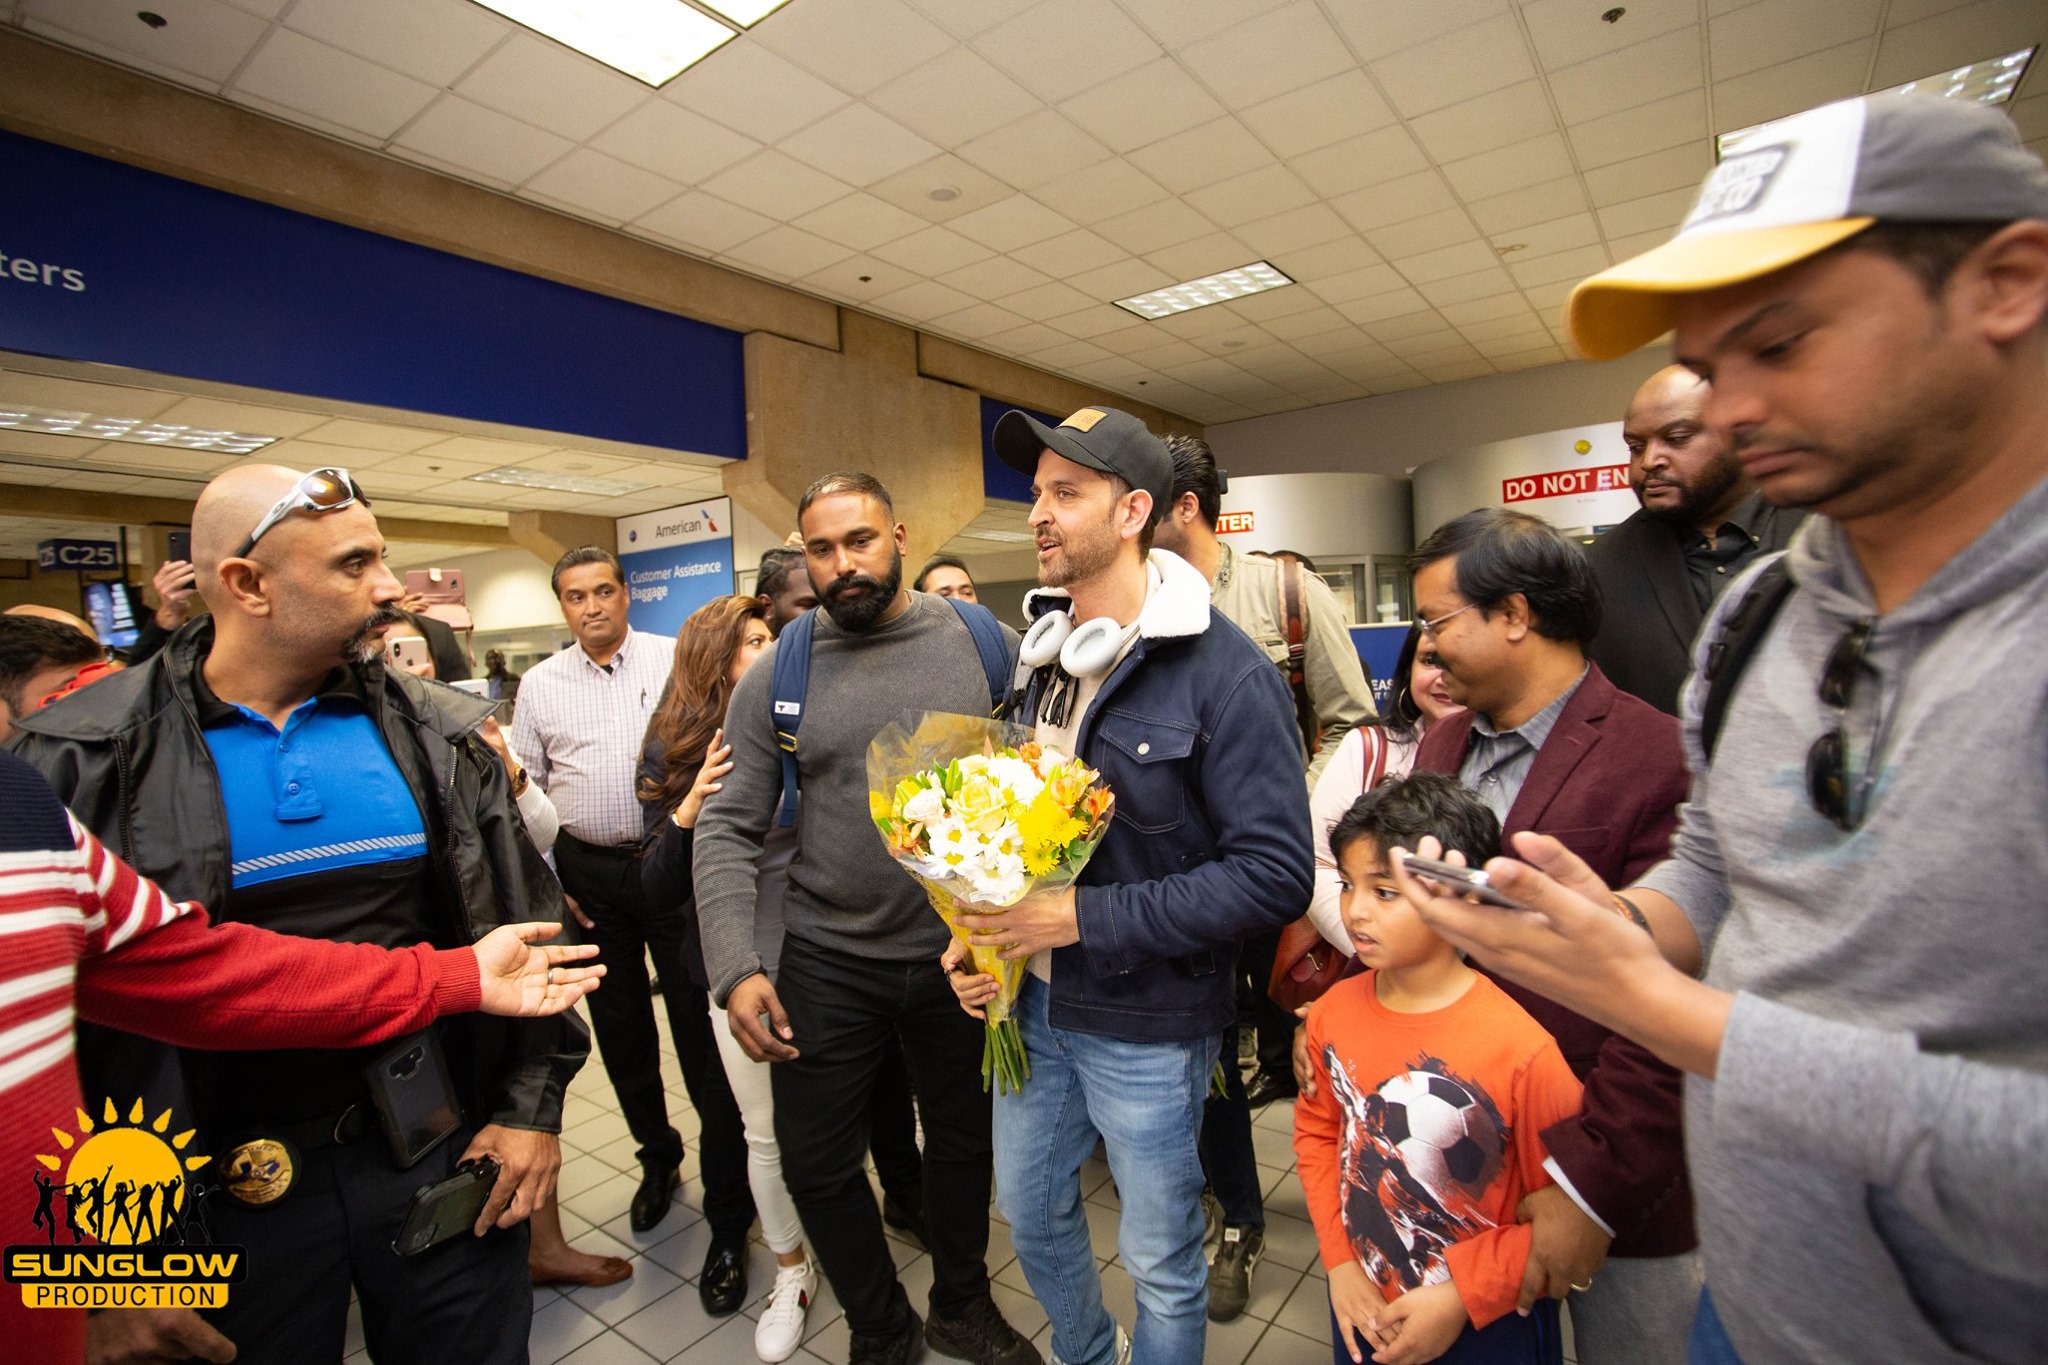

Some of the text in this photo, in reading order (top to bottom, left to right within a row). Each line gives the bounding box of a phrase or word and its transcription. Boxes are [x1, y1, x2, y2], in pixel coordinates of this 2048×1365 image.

[1506, 467, 1630, 500] DO NOT EN
[655, 519, 701, 538] American
[1215, 514, 1253, 531] TER
[59, 546, 115, 565] C25
[630, 561, 721, 584] Customer Assistance
[631, 585, 668, 603] Baggage
